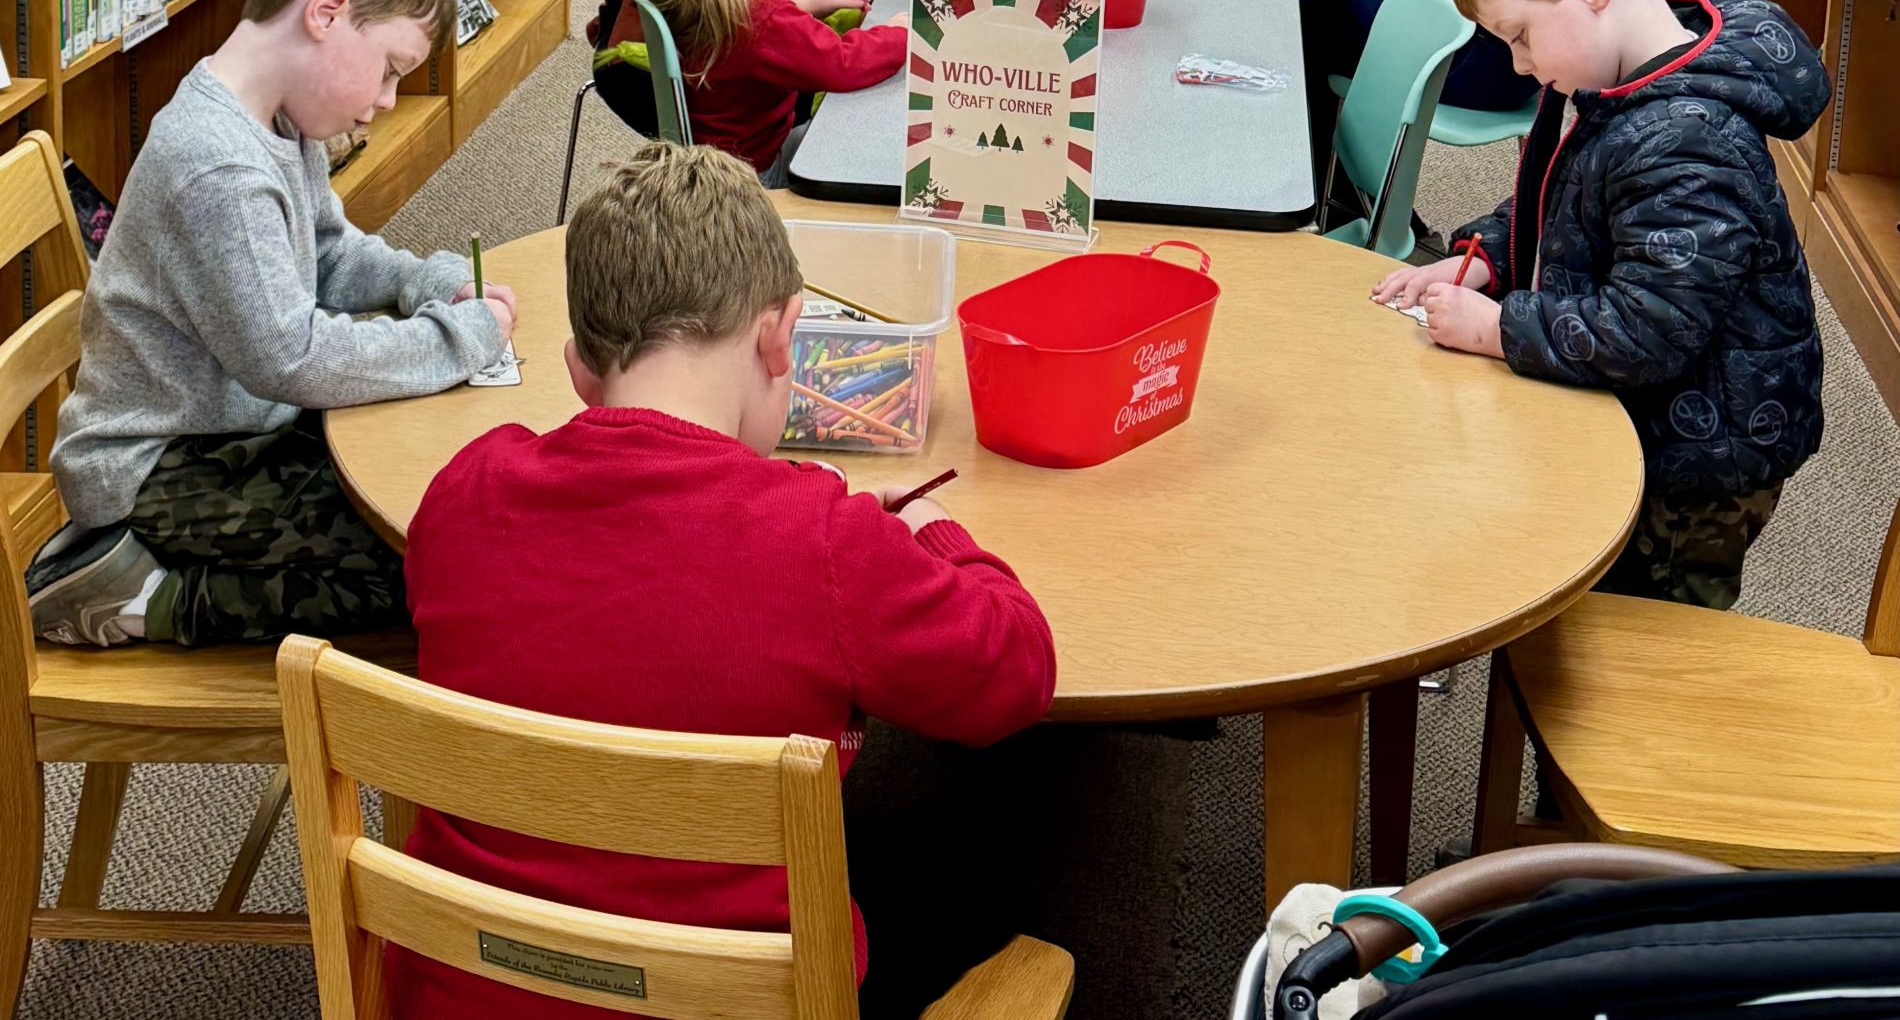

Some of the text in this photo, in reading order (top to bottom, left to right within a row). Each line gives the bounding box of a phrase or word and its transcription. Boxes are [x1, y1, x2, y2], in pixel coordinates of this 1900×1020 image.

[941, 60, 1061, 94] WHO-VILLE
[947, 89, 1053, 117] CRAFT CORNER
[1133, 338, 1188, 373] Believe
[1142, 371, 1170, 391] magic
[1114, 387, 1184, 435] Christmas
[521, 962, 532, 971] the
